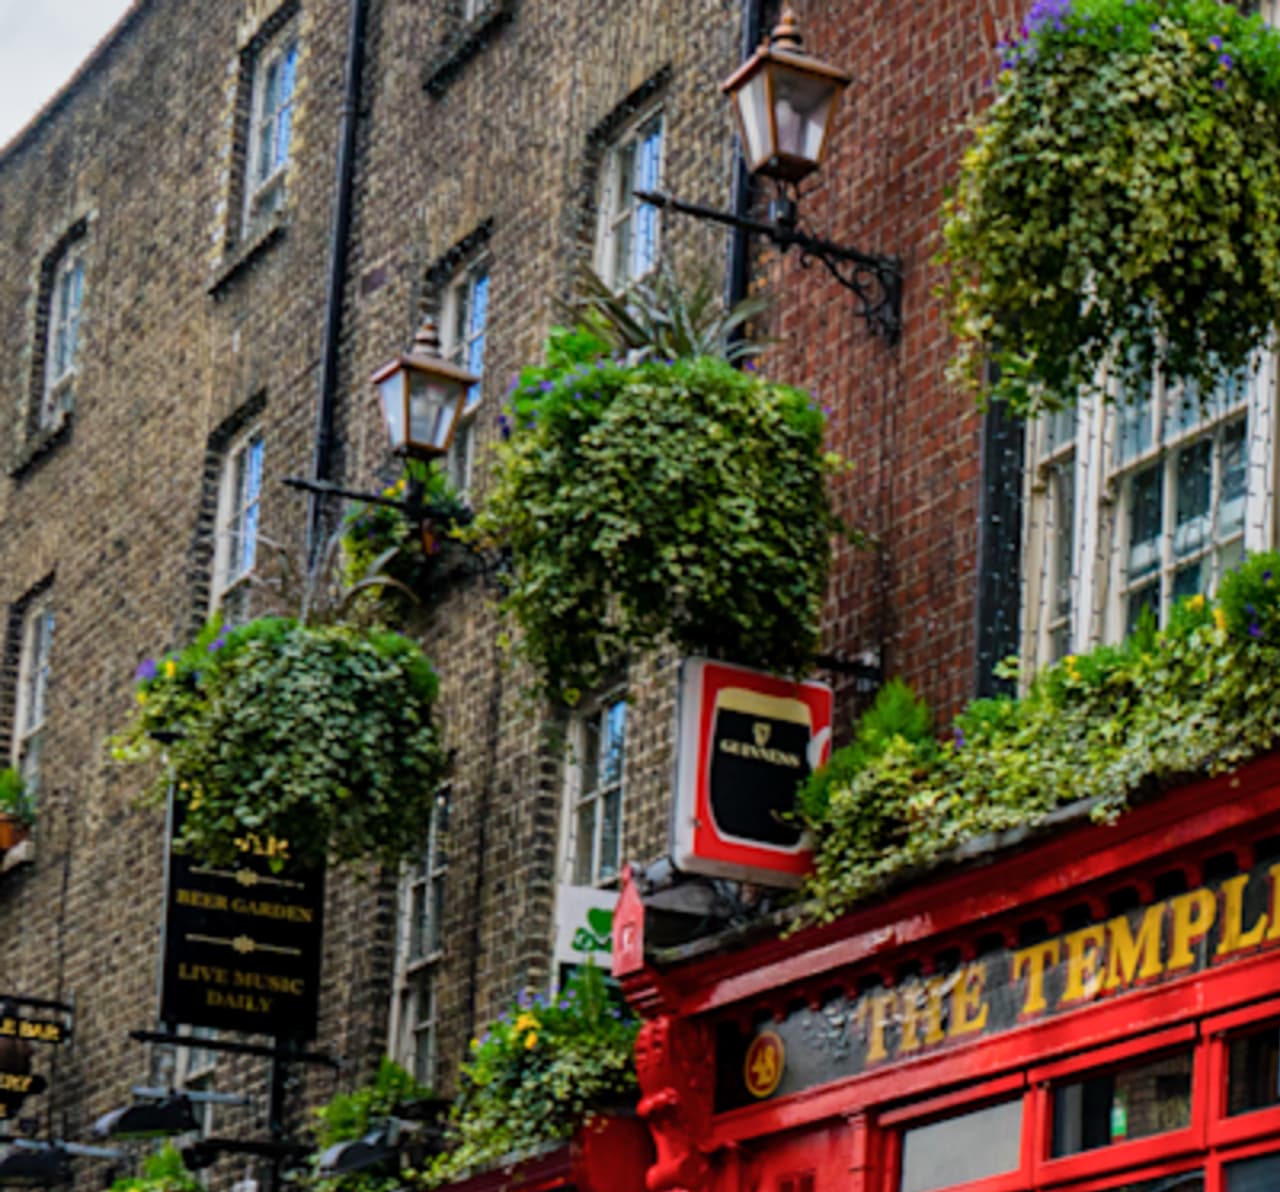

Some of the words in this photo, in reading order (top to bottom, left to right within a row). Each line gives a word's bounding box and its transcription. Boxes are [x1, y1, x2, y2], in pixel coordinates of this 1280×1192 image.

[719, 737, 800, 768] GUINNESS
[176, 888, 229, 912] BEER
[232, 897, 314, 923] GARDEN
[178, 962, 229, 983] LIVE
[234, 967, 305, 995] MUSIC
[206, 988, 273, 1014] DAILY
[860, 960, 989, 1063] THE
[750, 1040, 779, 1088] 48
